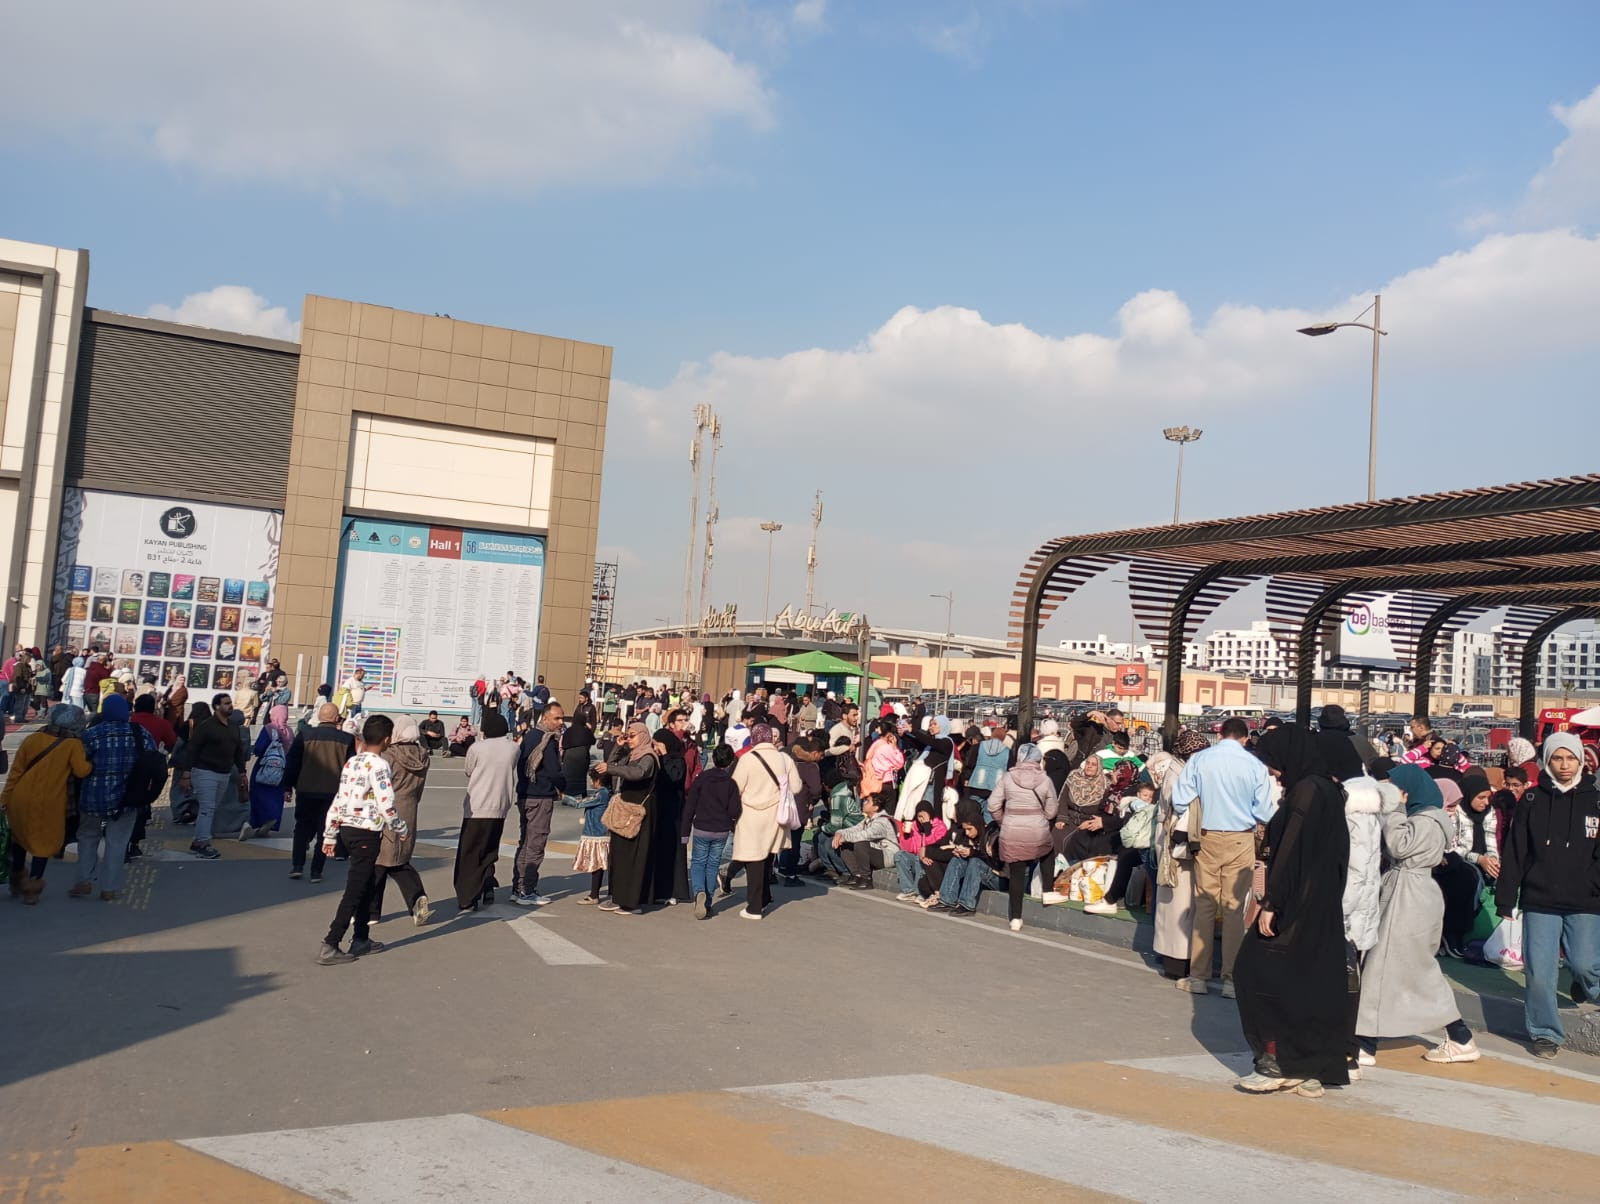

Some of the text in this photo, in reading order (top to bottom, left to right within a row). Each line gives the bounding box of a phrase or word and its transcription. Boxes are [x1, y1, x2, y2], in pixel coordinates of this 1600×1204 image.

[144, 538, 207, 551] KAYAN PUBLISHING
[430, 539, 461, 551] Hall 1
[1351, 609, 1367, 625] be
[1585, 826, 1599, 839] YO
